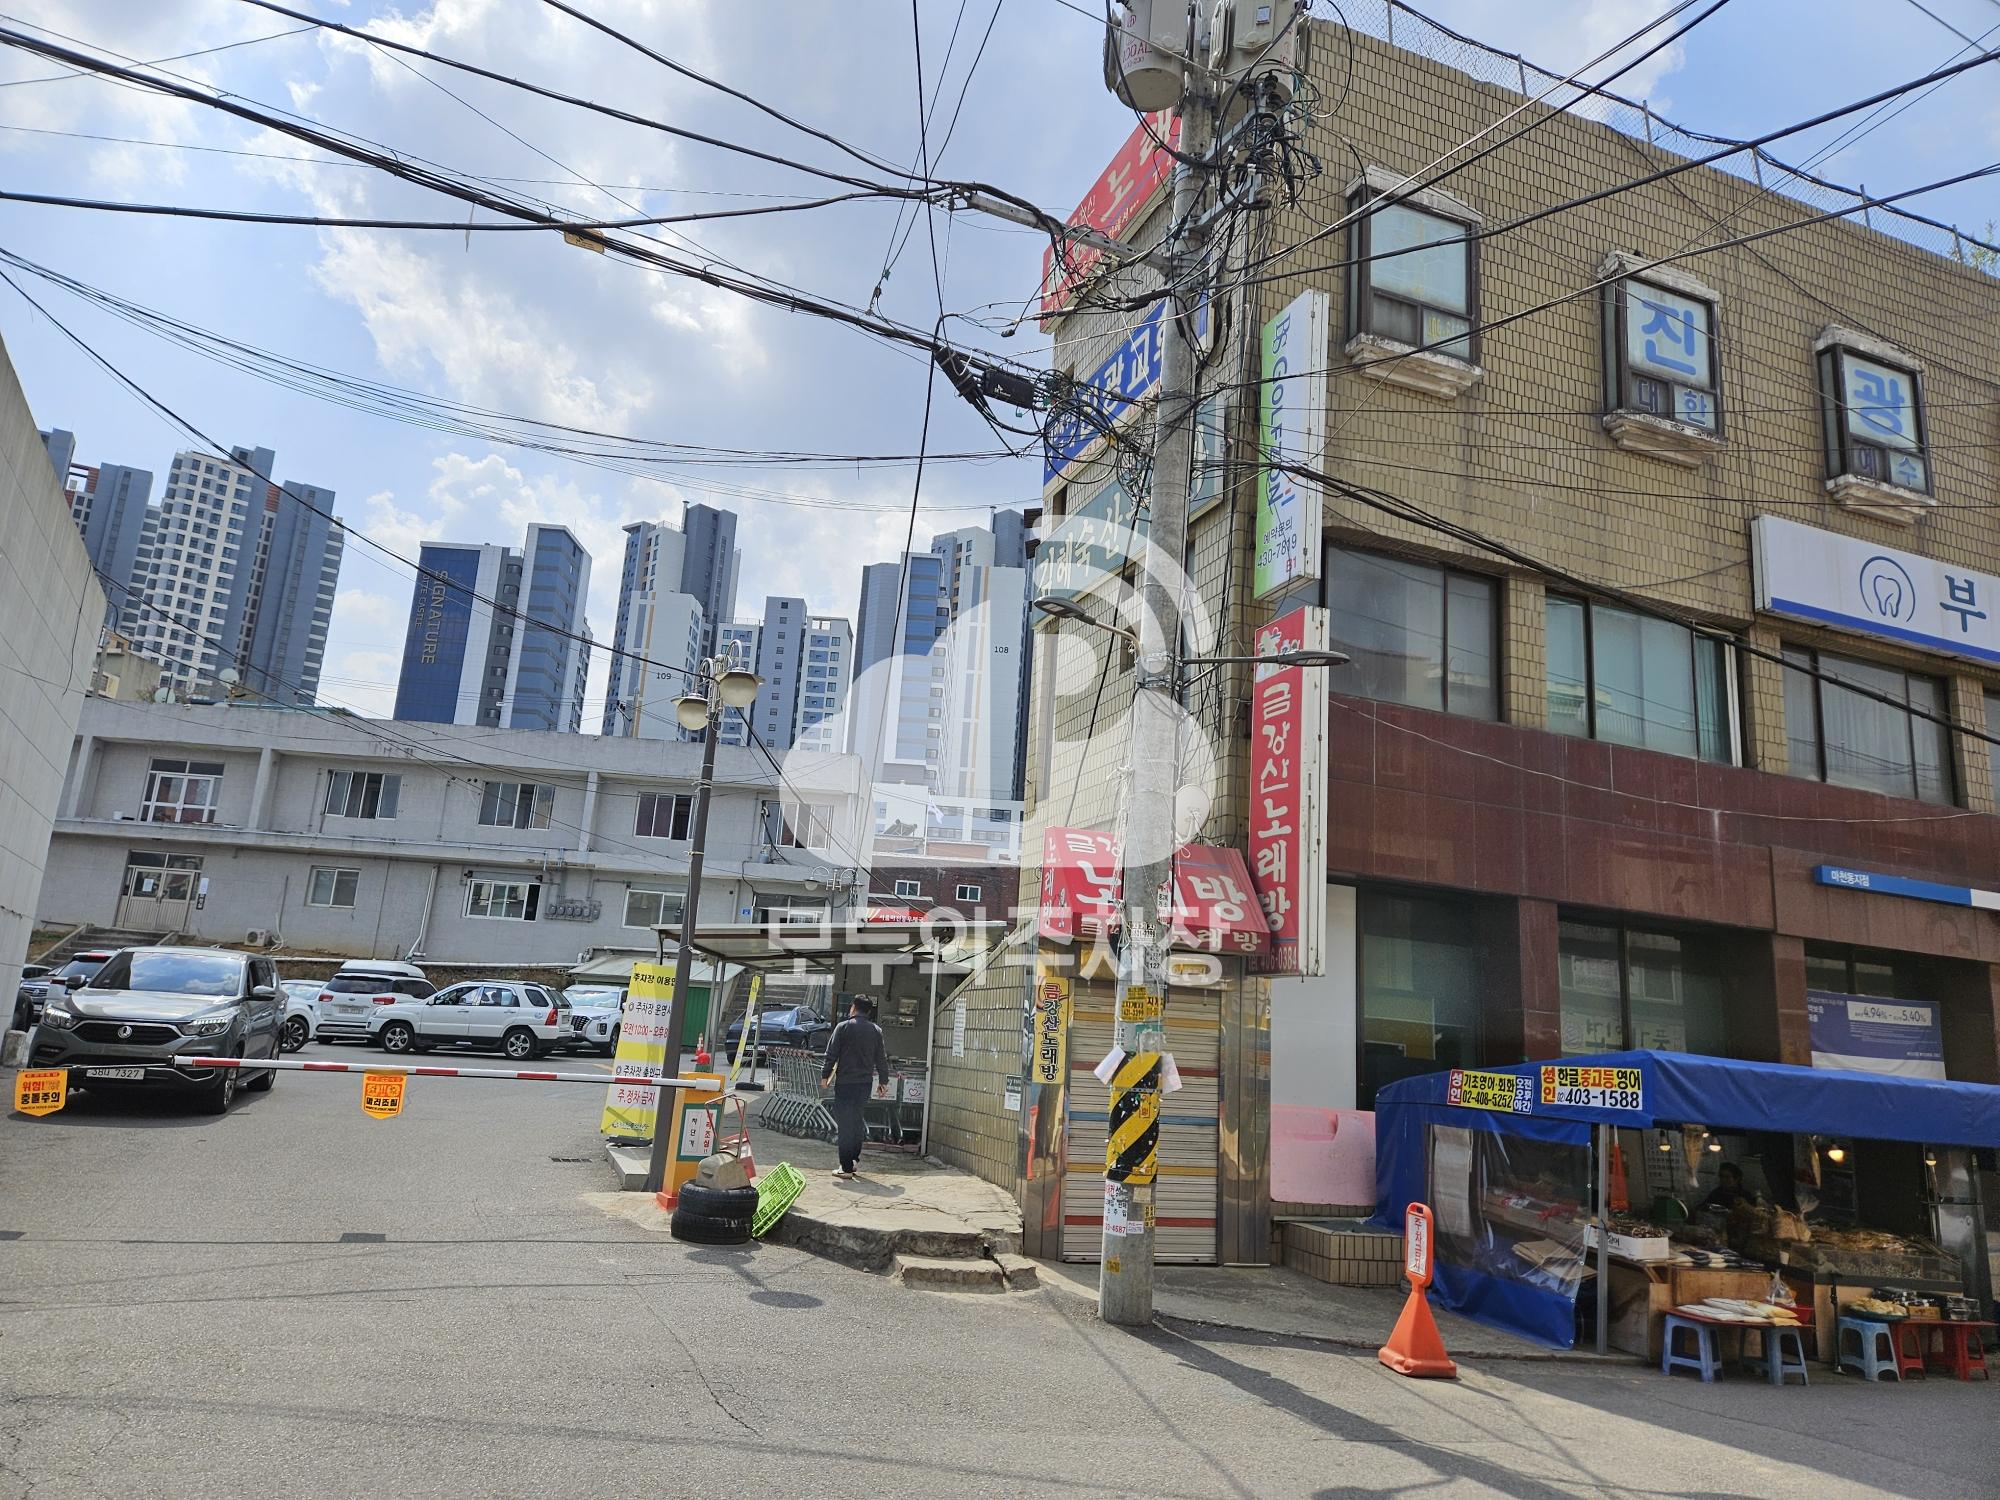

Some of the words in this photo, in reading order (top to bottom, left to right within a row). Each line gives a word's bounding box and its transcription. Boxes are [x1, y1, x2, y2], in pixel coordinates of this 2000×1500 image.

[1640, 298, 1697, 376] 진
[1853, 367, 1906, 437] 광
[1257, 533, 1298, 568] 430-7819
[1938, 573, 1988, 634] 부
[421, 569, 449, 664] SIGNATURE
[994, 645, 1009, 654] 108
[656, 671, 672, 680] 109
[1257, 681, 1293, 933] 금강산노래방
[633, 972, 655, 984] 주차장
[635, 1001, 654, 1016] 주차장
[1041, 982, 1063, 1082] 금강산노래방
[114, 1068, 140, 1079] 7327
[641, 1091, 656, 1107] 금지
[1462, 1089, 1513, 1109] 02-408-5252
[1565, 1088, 1640, 1109] 403-1588
